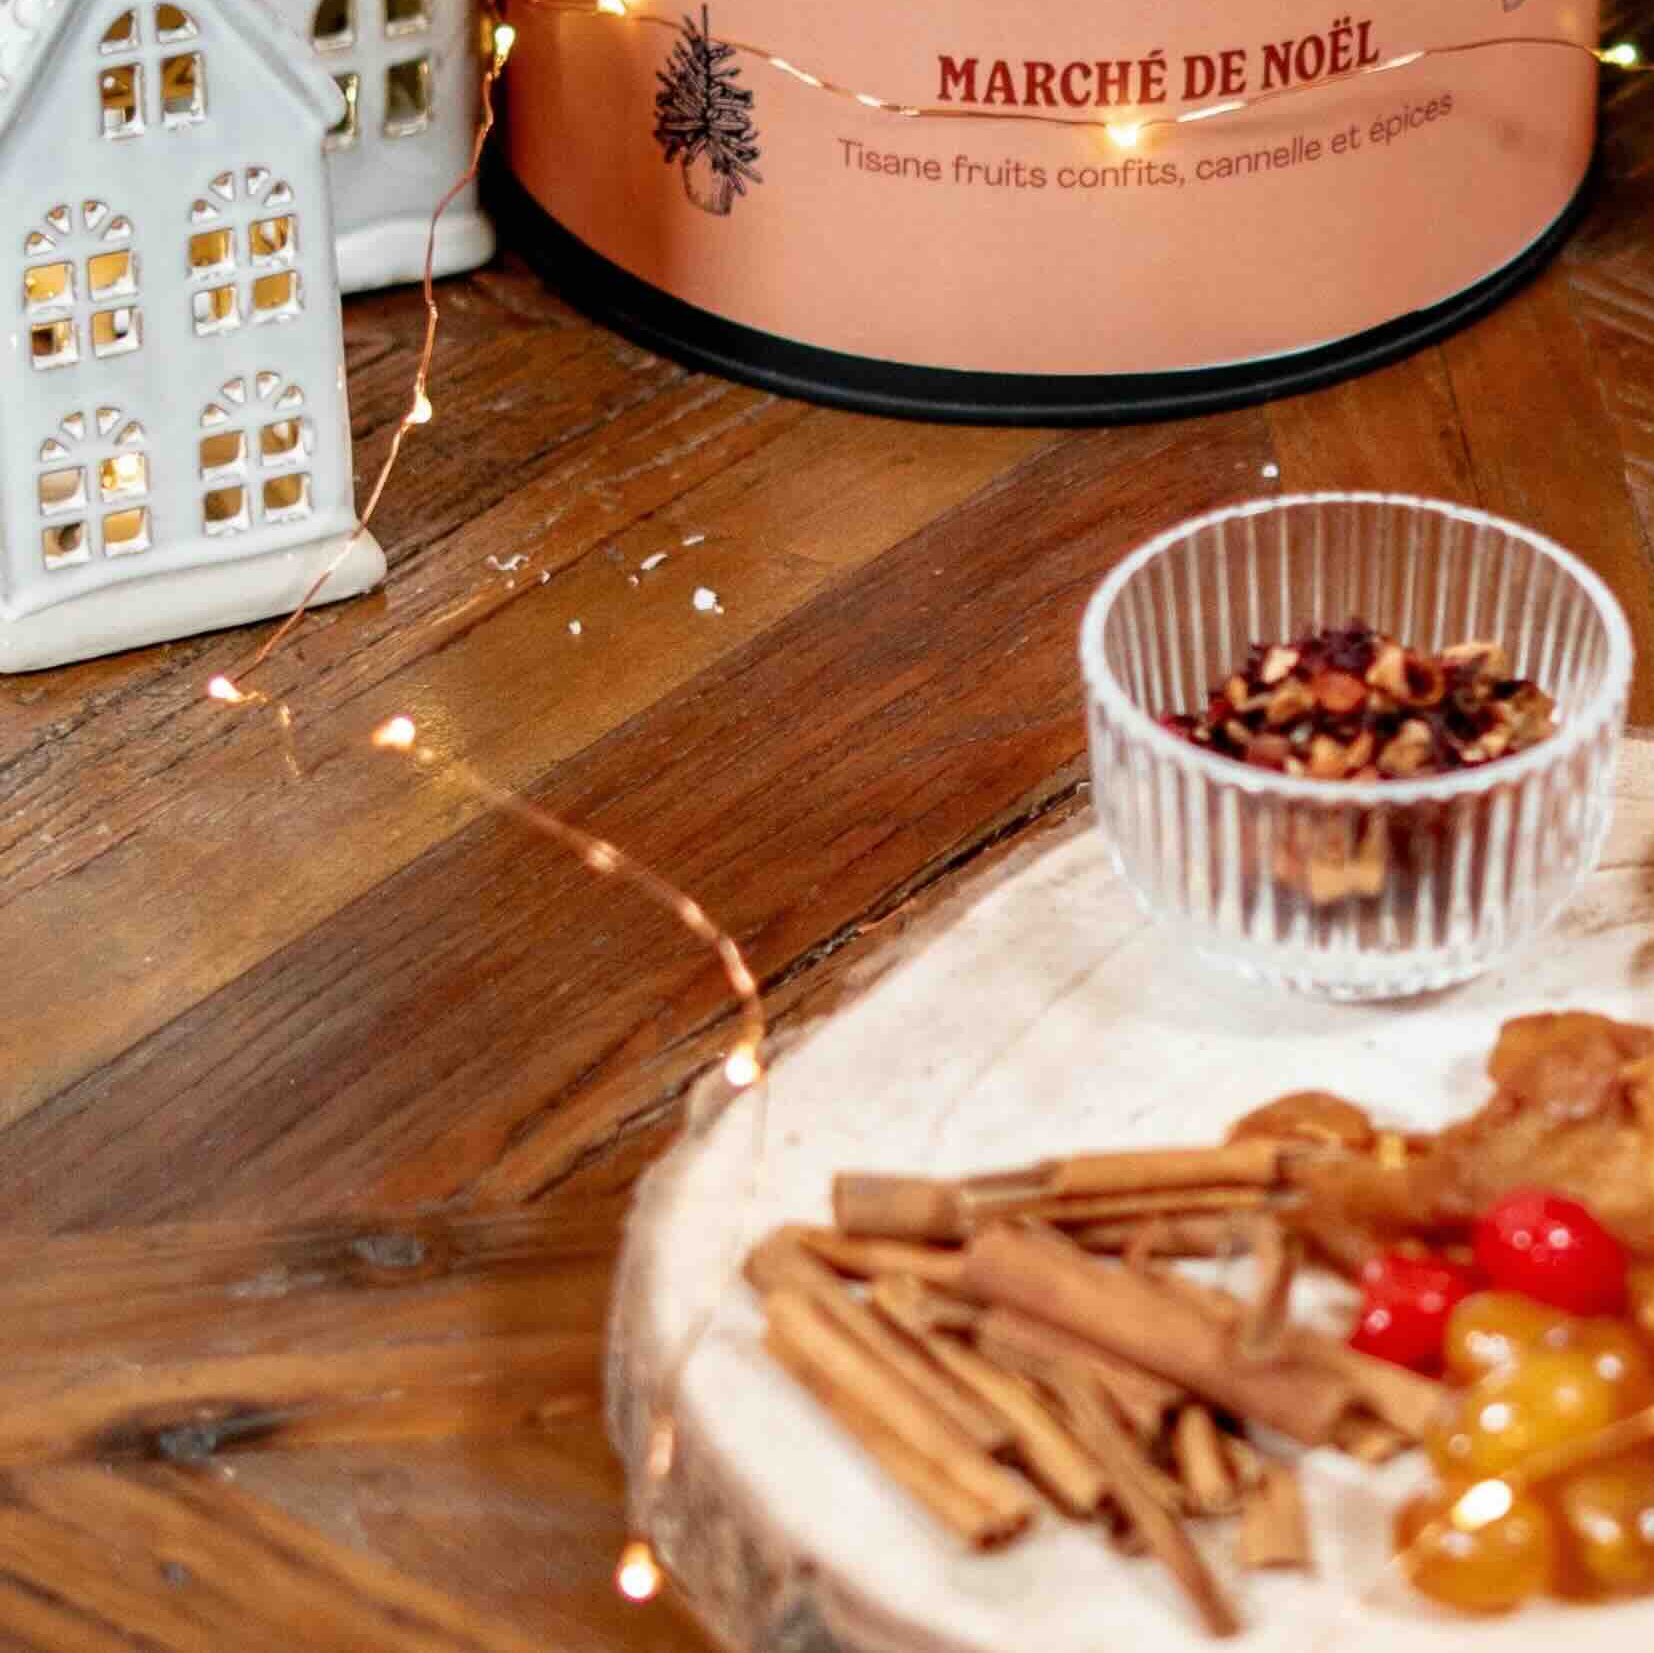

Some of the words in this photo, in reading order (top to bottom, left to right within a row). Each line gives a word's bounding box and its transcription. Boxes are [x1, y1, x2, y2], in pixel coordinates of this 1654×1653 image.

[937, 49, 1169, 106] MARCHÉ
[1180, 51, 1248, 100] DE
[1260, 16, 1380, 87] NOËL
[838, 137, 943, 182] Tisane
[951, 153, 1047, 190] fruits
[1056, 156, 1186, 190] confits,
[1195, 135, 1322, 181] cannelle
[1329, 123, 1360, 155] et
[1368, 91, 1454, 147] épices
